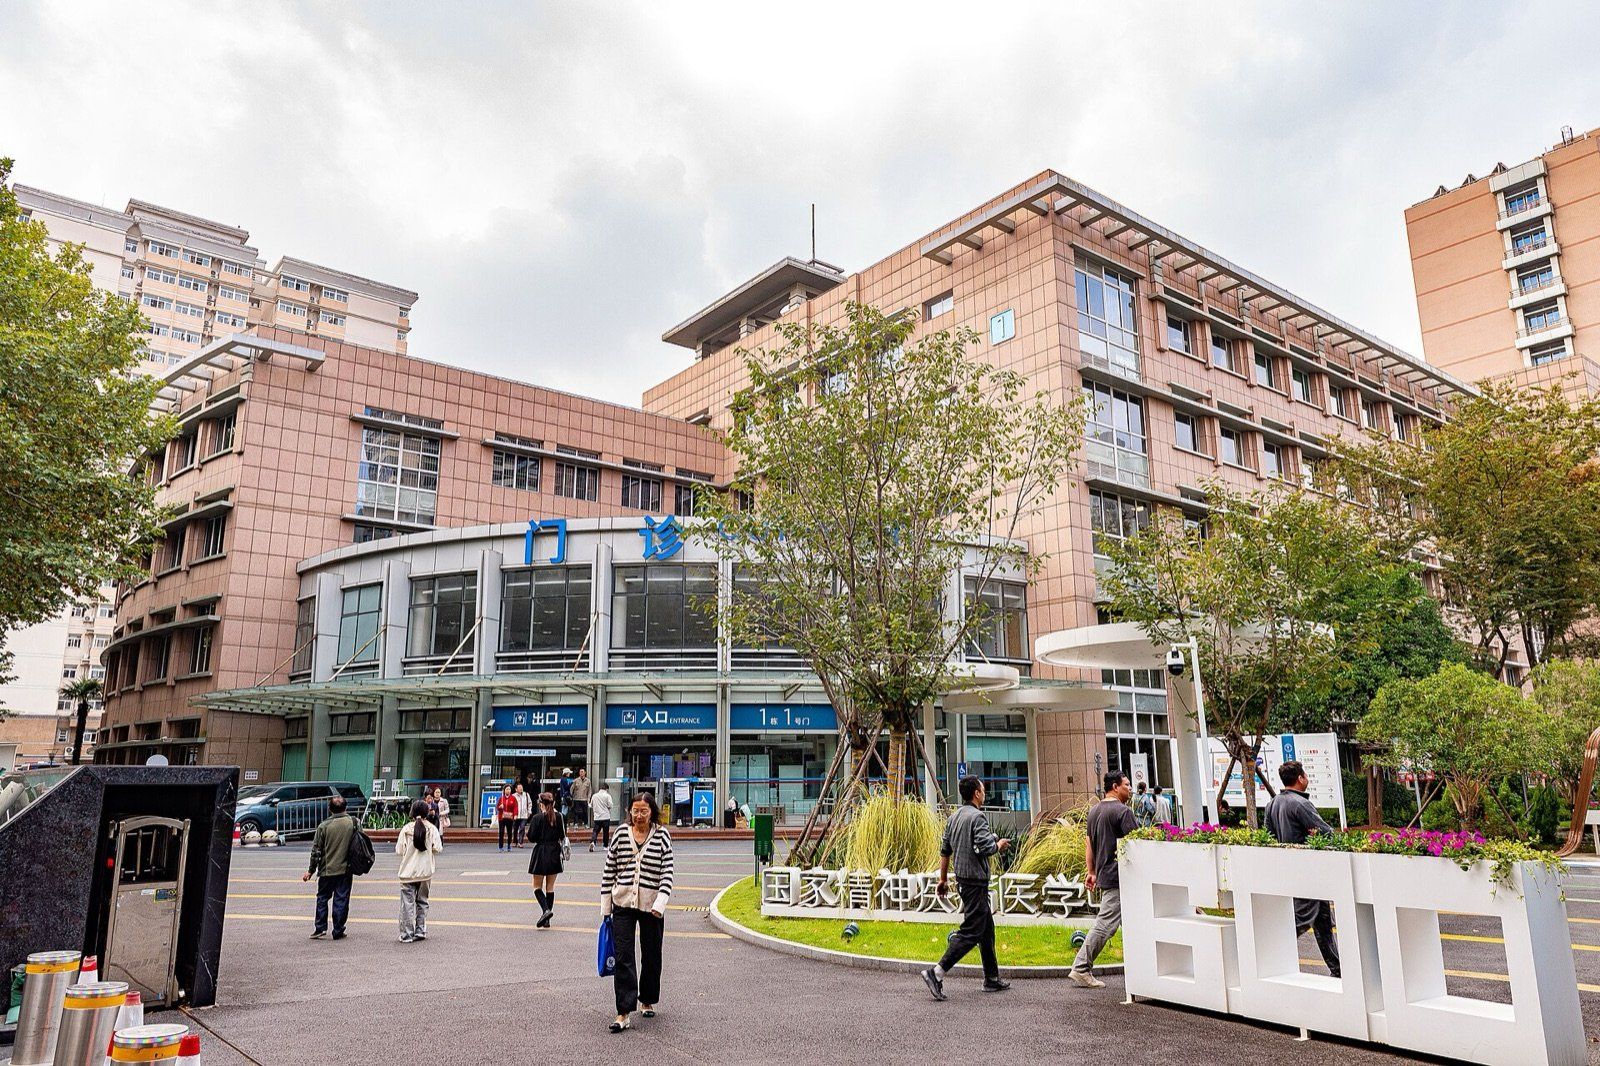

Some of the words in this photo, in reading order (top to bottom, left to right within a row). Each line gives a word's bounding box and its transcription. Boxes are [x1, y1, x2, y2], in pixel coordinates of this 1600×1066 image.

[524, 515, 684, 564] 门诊
[532, 711, 558, 726] 出口
[641, 711, 668, 725] 入口
[487, 795, 497, 815] 出口
[699, 794, 708, 815] 入口
